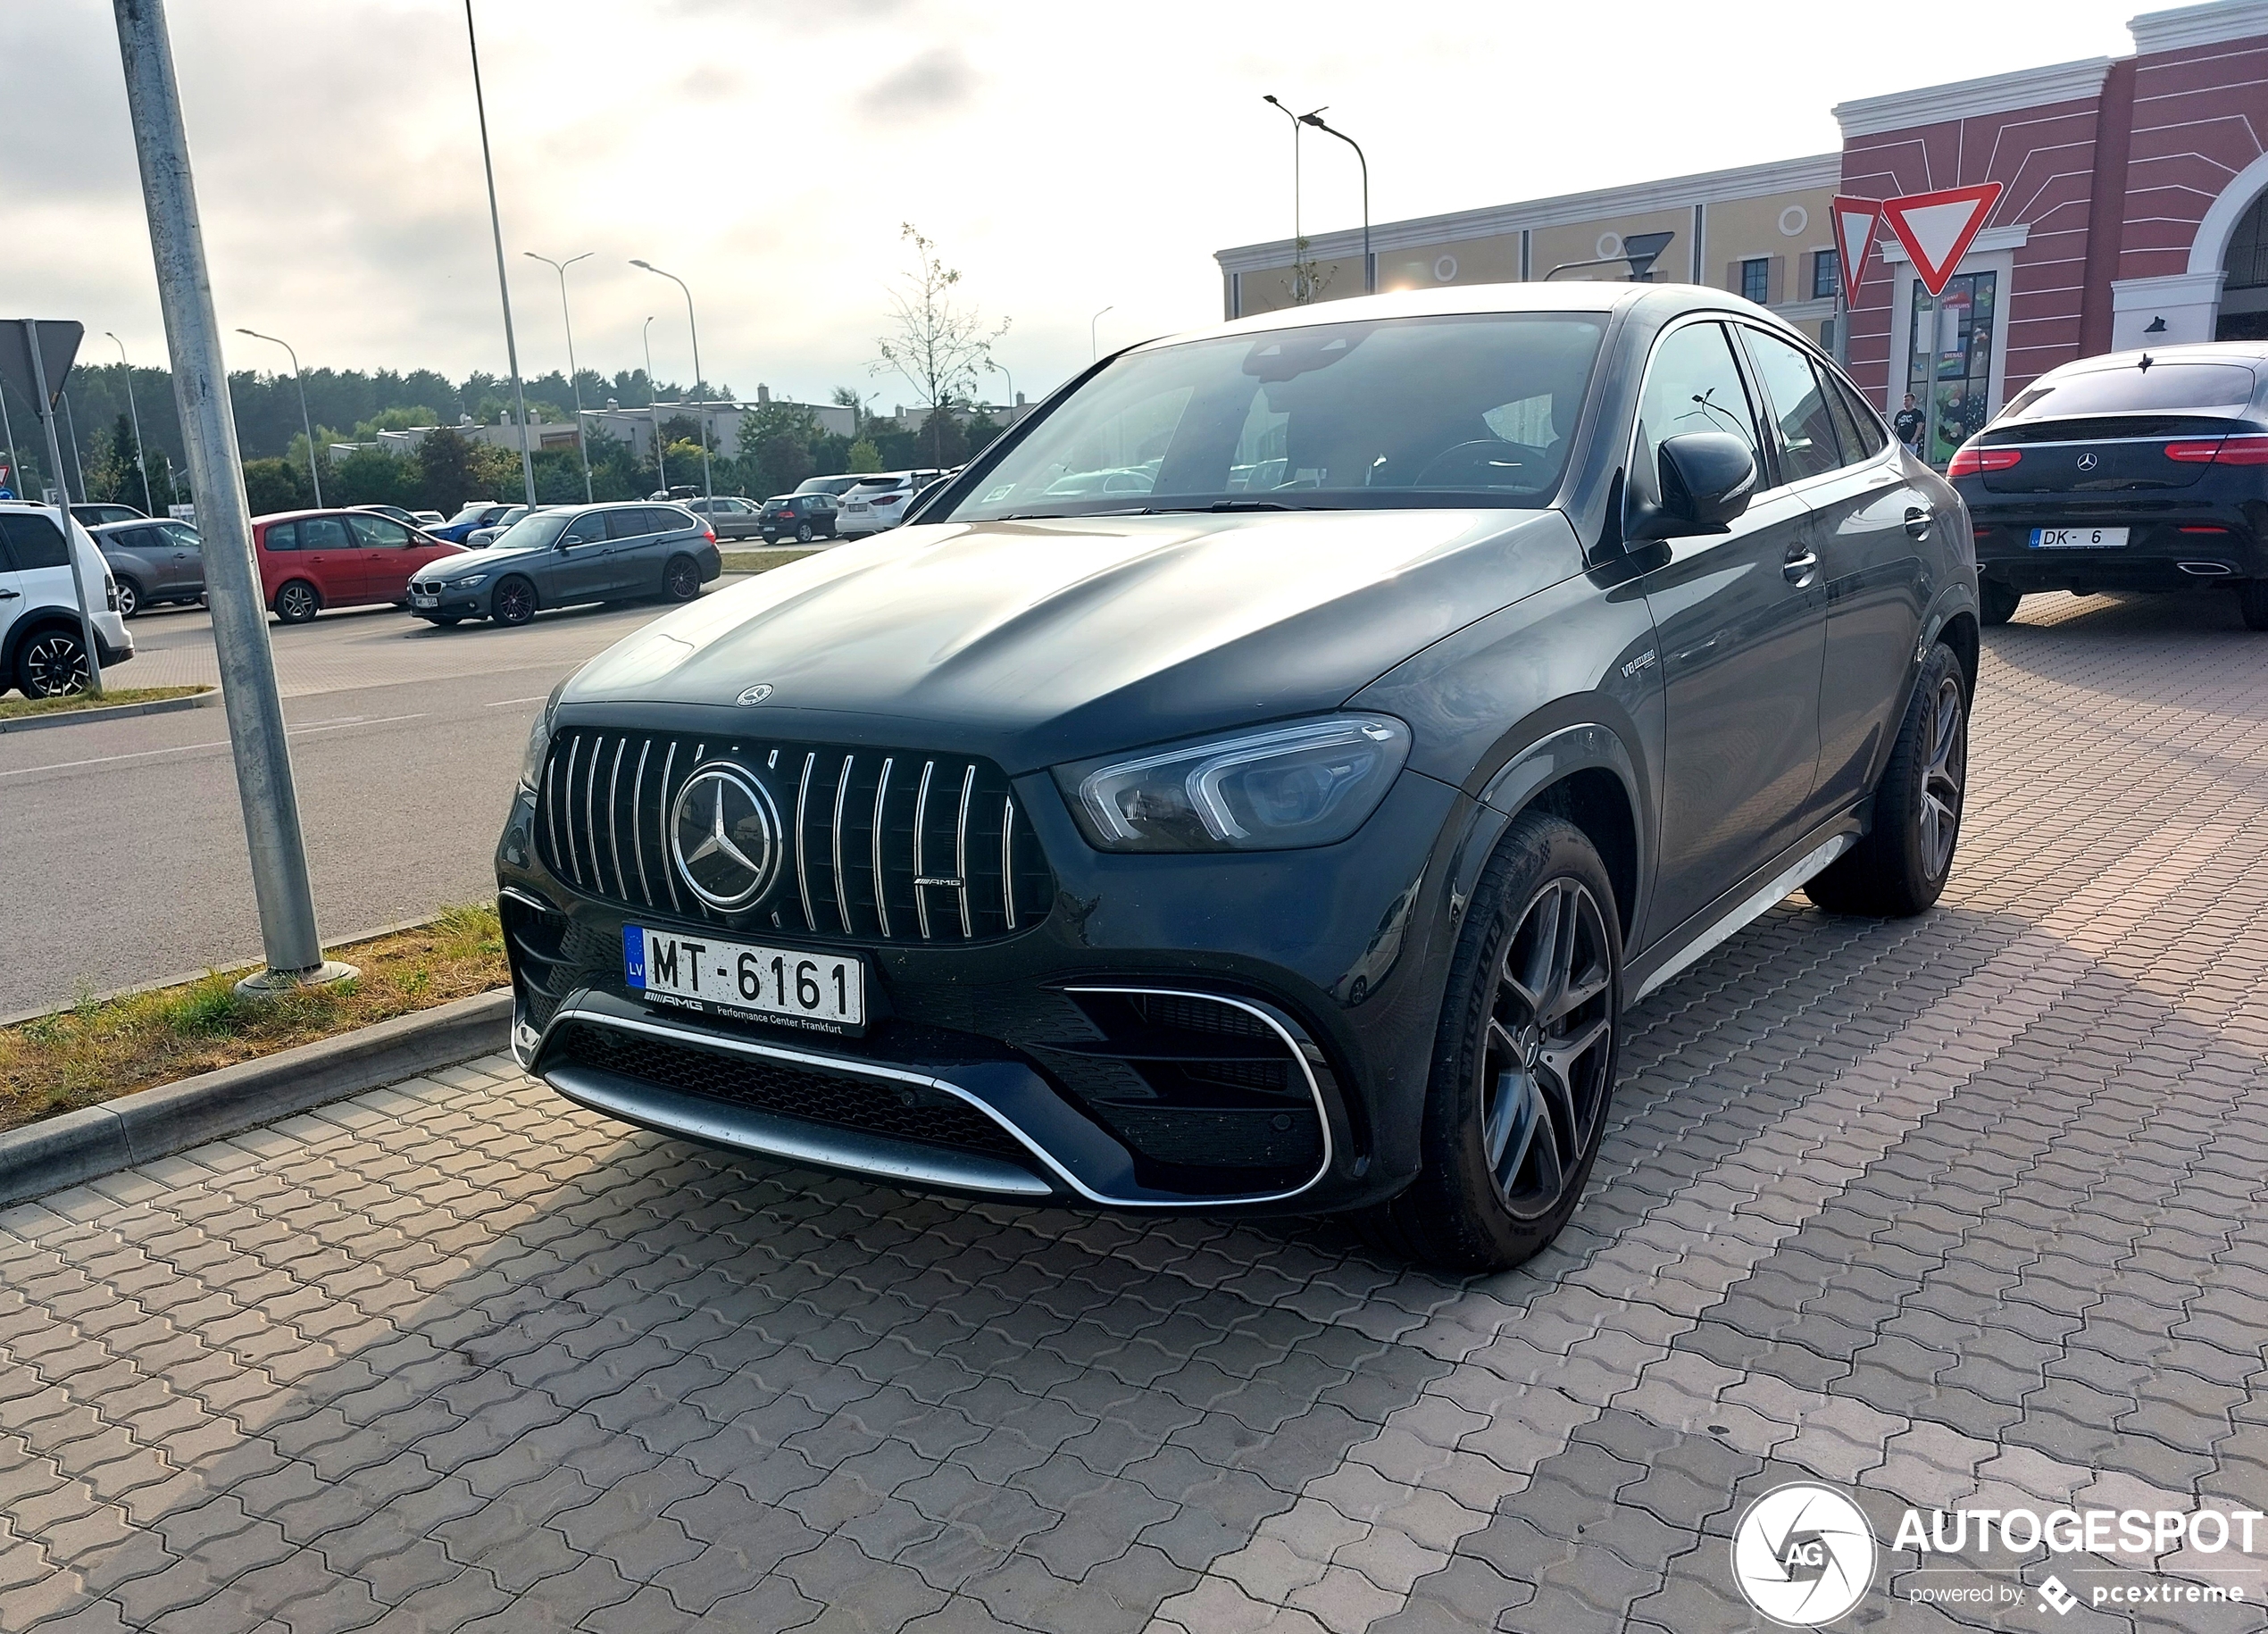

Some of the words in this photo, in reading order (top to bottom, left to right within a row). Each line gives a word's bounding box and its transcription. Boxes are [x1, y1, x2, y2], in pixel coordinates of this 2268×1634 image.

[2091, 529, 2102, 545] 6
[1621, 661, 1635, 679] V8
[929, 878, 962, 886] AMG
[629, 962, 644, 978] LV
[652, 936, 846, 1015] MT-6161
[663, 996, 704, 1011] AMG
[1462, 917, 1503, 1079] MICHELIN
[716, 1005, 769, 1023] Performance
[769, 1013, 799, 1029] Center
[801, 1019, 843, 1035] Frankfurt
